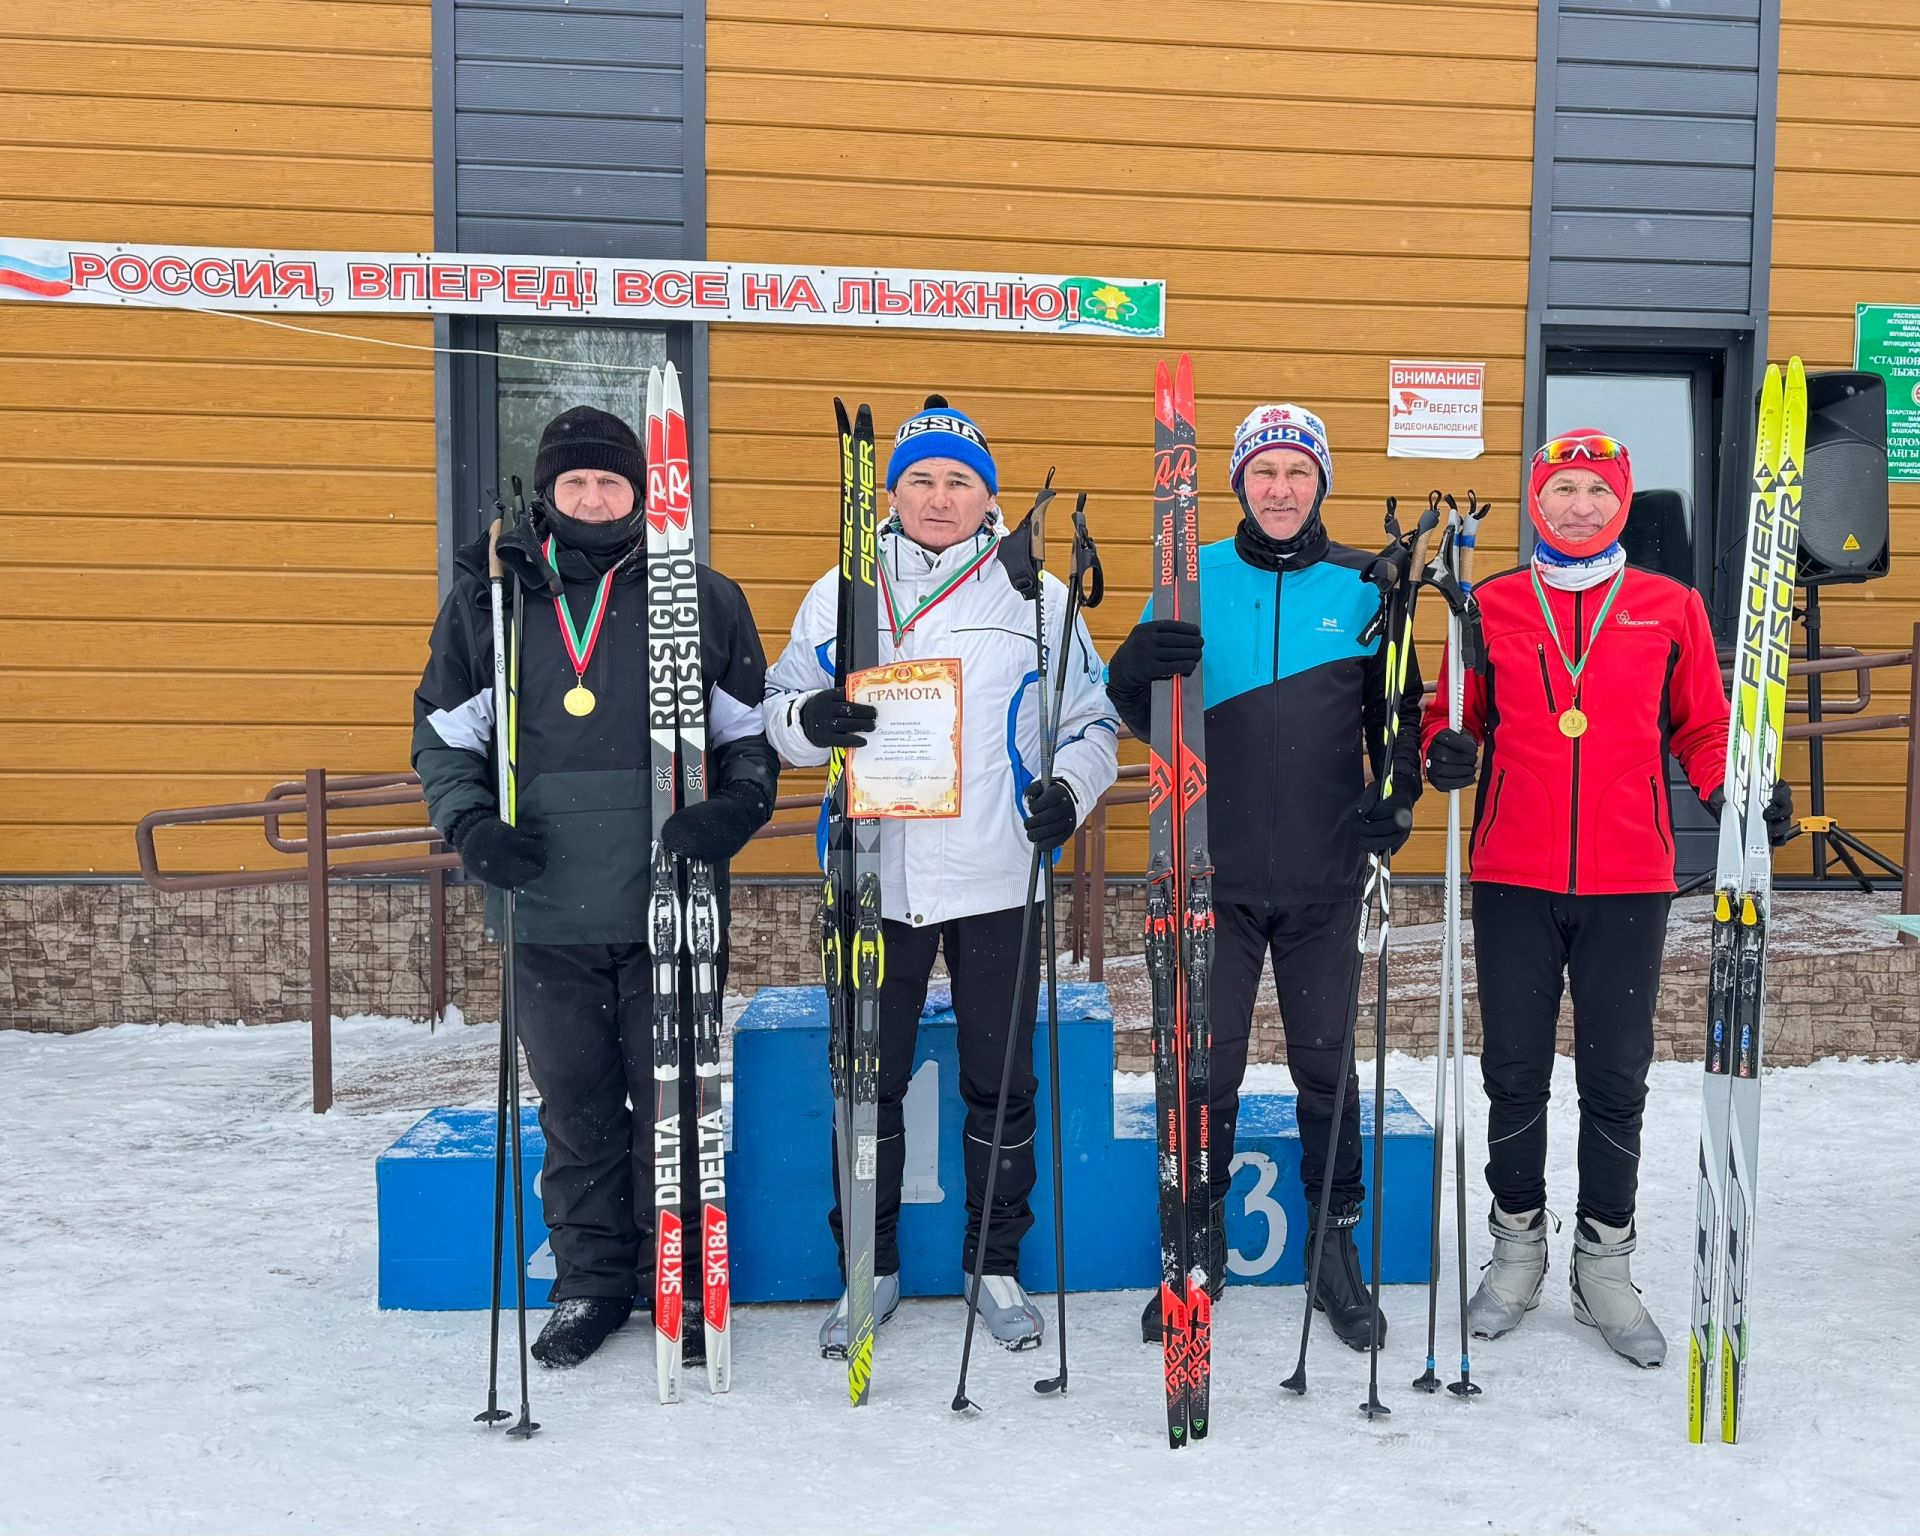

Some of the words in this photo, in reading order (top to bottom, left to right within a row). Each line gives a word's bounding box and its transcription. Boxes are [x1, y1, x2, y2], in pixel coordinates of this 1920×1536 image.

[69, 252, 335, 306] РОССИЯ,
[347, 262, 597, 311] ВПЕРЕД!
[613, 268, 730, 309] ВСЕ
[742, 273, 827, 313] НА
[833, 278, 1082, 323] ЛЫЖНЮ!
[1394, 371, 1480, 386] ВНИМАНИЕ!
[1429, 403, 1478, 415] ВЕДЕТСЯ
[895, 416, 980, 449] USSIA
[1394, 422, 1478, 432] ВИДЕОНАБЛЮДЕНИЕ
[842, 432, 854, 582] FISCHER
[859, 439, 876, 587] FISCHER
[1161, 509, 1174, 586] ROSSIGNOL
[1186, 505, 1198, 582] ROSSIGNOL
[1741, 498, 1776, 689] FISCHER
[1766, 492, 1802, 687] FISCHER
[648, 541, 676, 730] ROSSIGNOL
[669, 538, 706, 729] ROSSIGNOL
[867, 687, 942, 703] ГРАМОТА
[656, 766, 672, 791] SK
[687, 764, 703, 790] SK
[654, 1113, 681, 1206] DELTA
[697, 1107, 726, 1200] DELTA
[900, 1059, 946, 1204] 1
[1168, 1108, 1176, 1152] PREMIUM
[1200, 1104, 1208, 1148] PREMIUM
[1170, 1154, 1179, 1188] X-IUM
[1200, 1151, 1209, 1184] X-IUM
[1225, 1151, 1288, 1277] 3
[662, 1227, 682, 1296] SK186
[707, 1219, 728, 1287] SK186
